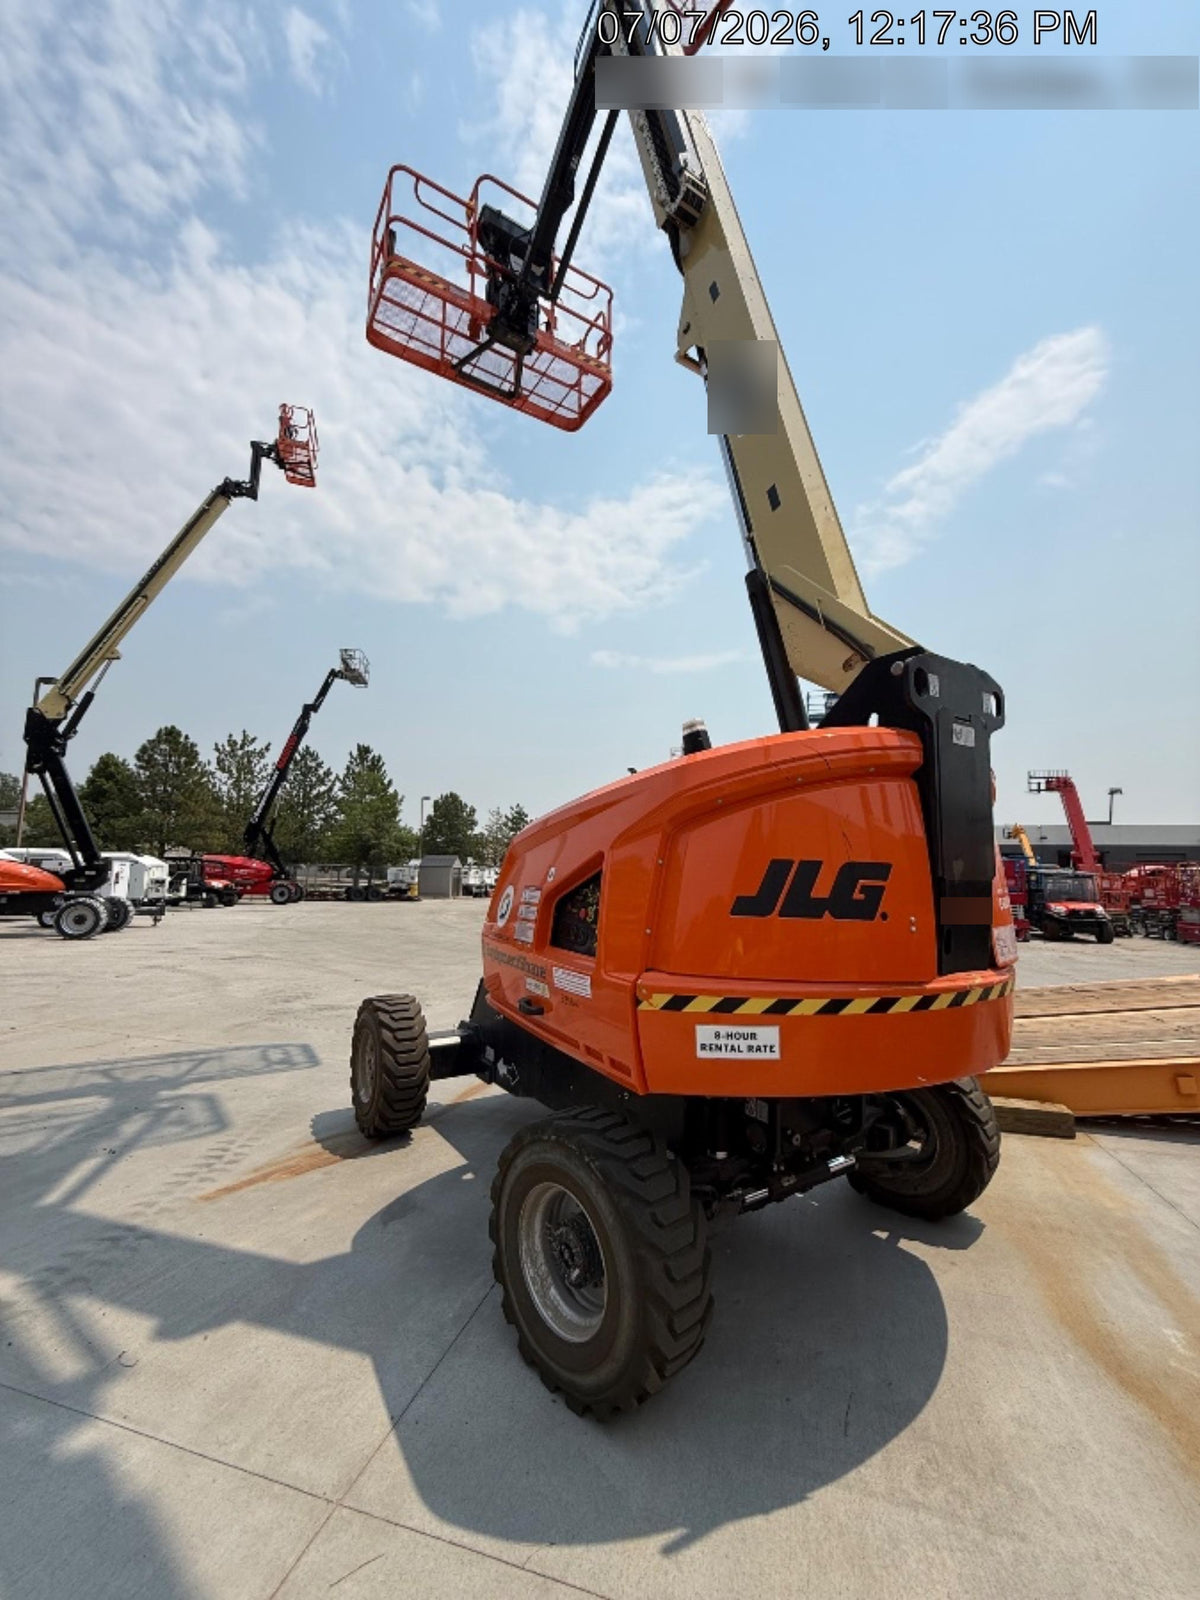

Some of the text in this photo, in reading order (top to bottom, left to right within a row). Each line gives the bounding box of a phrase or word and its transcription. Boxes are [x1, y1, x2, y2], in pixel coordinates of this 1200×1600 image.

[729, 858, 893, 922] JLG
[714, 1031, 758, 1041] 8-HOUR
[700, 1043, 776, 1053] RENTAL RATE
